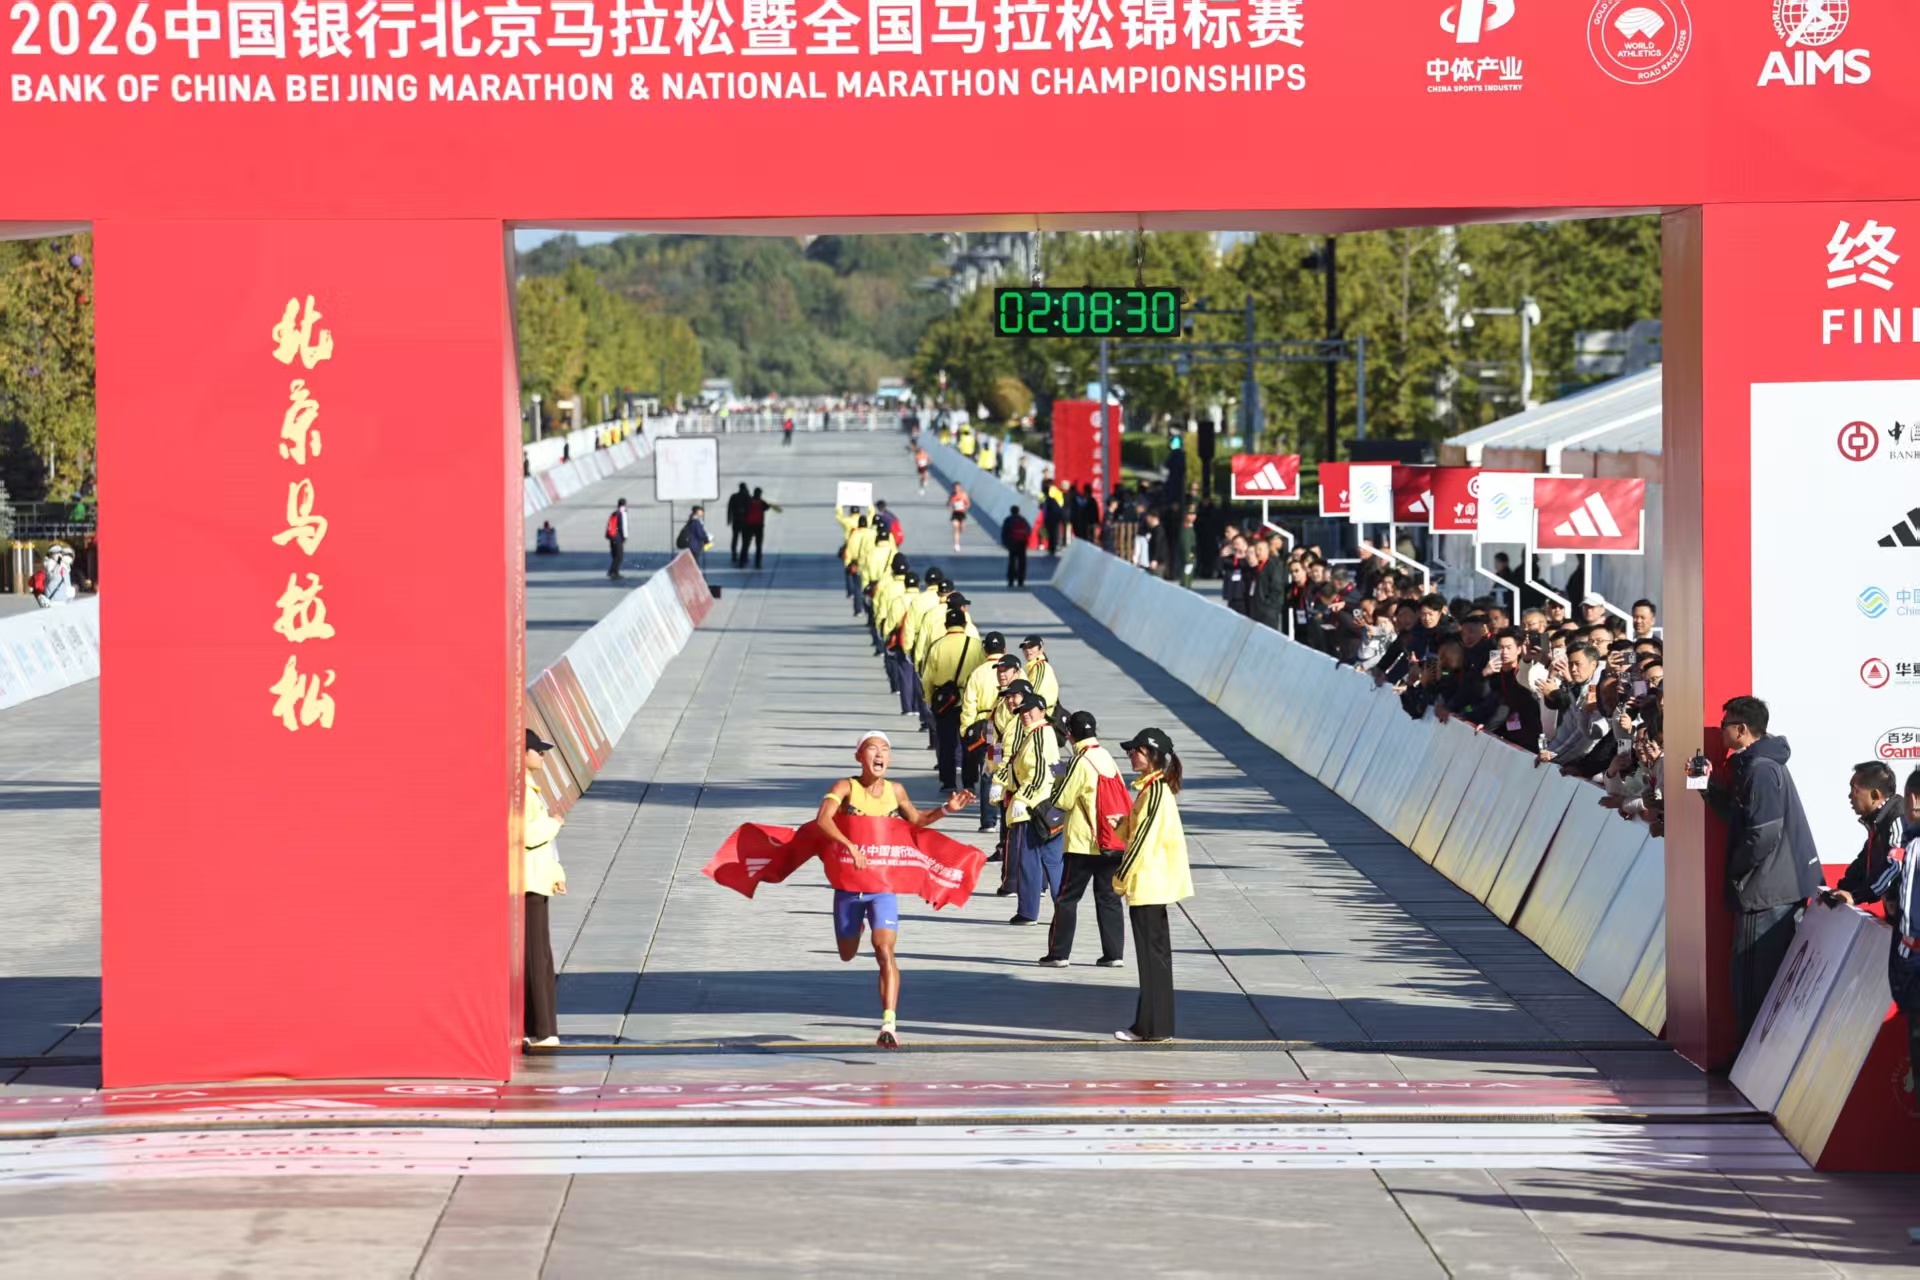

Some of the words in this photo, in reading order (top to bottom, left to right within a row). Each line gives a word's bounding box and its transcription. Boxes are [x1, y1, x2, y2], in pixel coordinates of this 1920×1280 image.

[11, 0, 1305, 58] 2026中国银行北京马拉松暨全国马拉松锦标赛
[1624, 41, 1655, 50] WORLD
[1426, 56, 1523, 82] 中体产业
[1617, 49, 1662, 57] ATHLETICS
[1637, 68, 1661, 79] ROAD
[1661, 52, 1680, 71] RACE
[1756, 48, 1871, 86] AIMS
[12, 75, 106, 101] BANK
[118, 75, 159, 101] OF
[172, 75, 275, 101] CHINA
[430, 73, 612, 101] MARATHON
[630, 73, 649, 100] &
[663, 71, 826, 99] NATIONAL
[838, 69, 1018, 98] MARATHON
[1032, 64, 1306, 94] CHAMPIONSHIPS
[1427, 85, 1453, 93] CHINA
[1453, 84, 1483, 92] SPORTS
[1484, 83, 1523, 92] INDUSTRY
[1826, 219, 1901, 291] 终
[1000, 292, 1175, 333] 02:08:30
[269, 294, 336, 732] 北京马拉松
